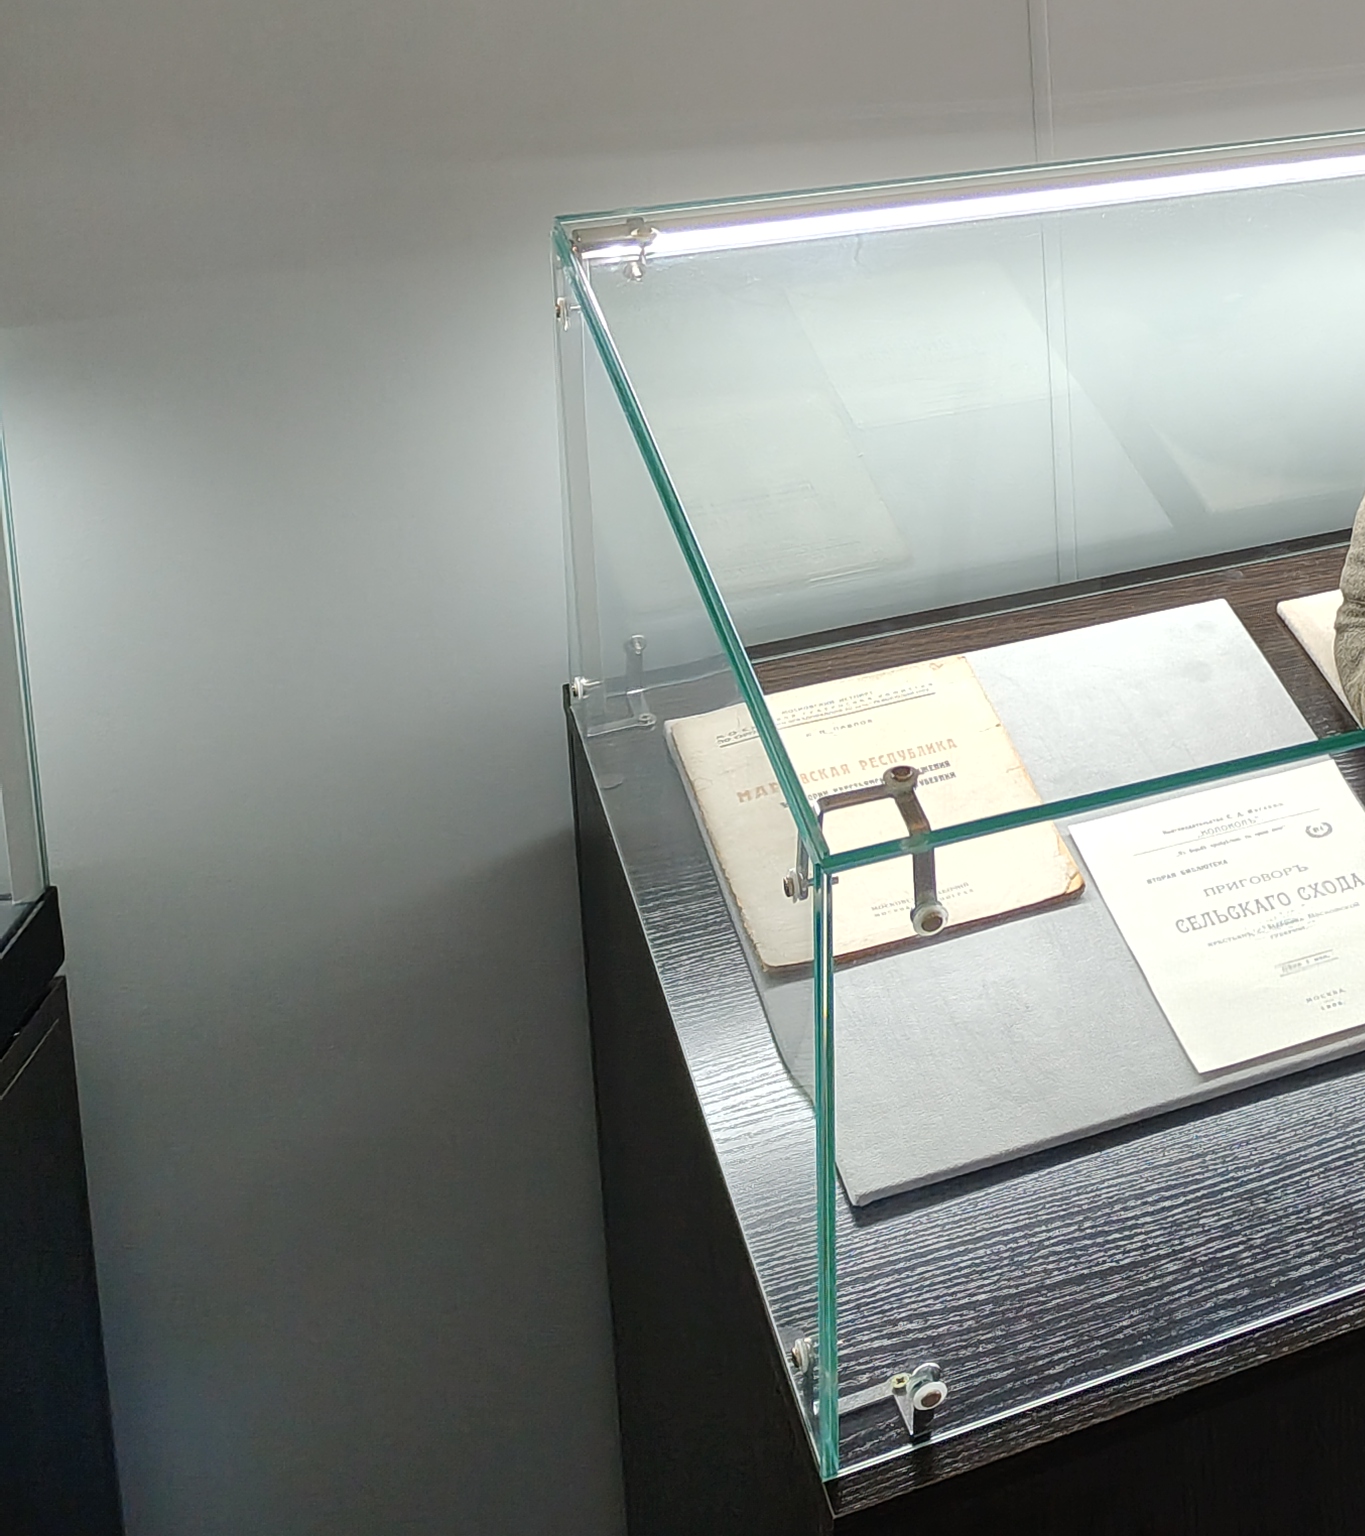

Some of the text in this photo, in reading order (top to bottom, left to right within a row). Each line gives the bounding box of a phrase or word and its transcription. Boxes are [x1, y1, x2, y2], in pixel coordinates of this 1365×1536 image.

[858, 738, 958, 771] РЕСПУБЛИКА
[1203, 864, 1310, 897] ПРИГОВОРЪ
[1175, 892, 1292, 934] СЕЛЬСКАГО
